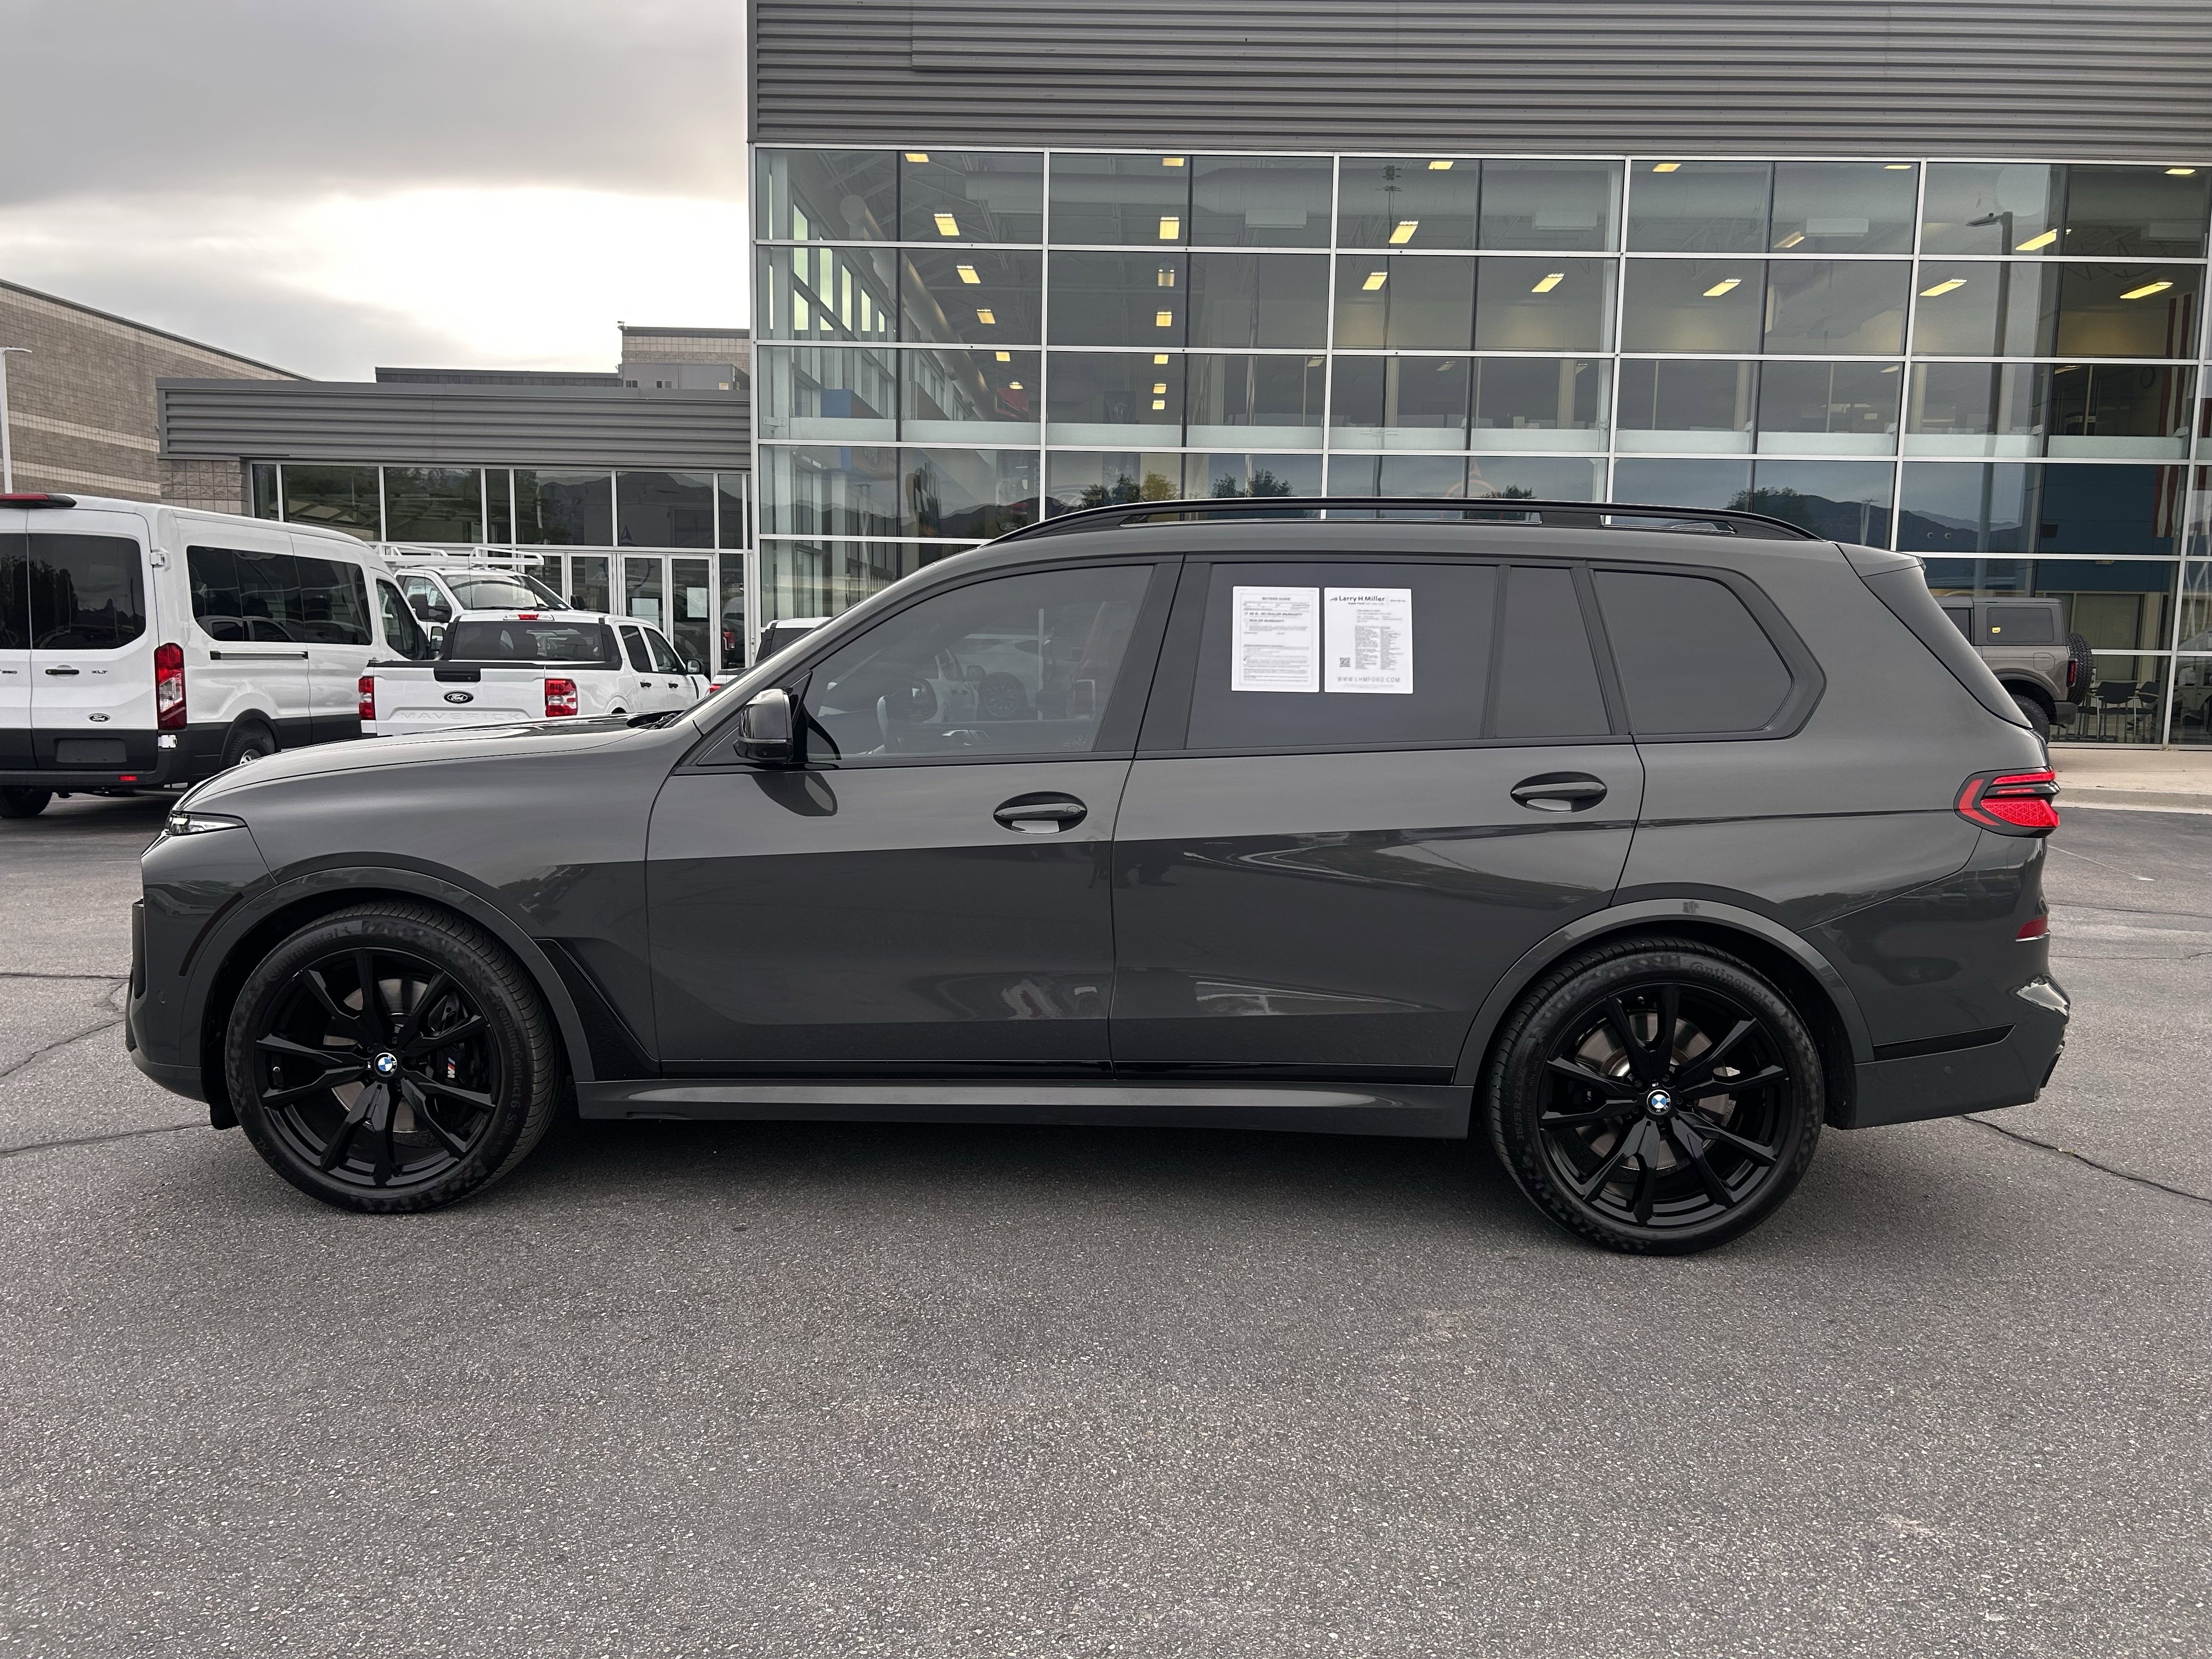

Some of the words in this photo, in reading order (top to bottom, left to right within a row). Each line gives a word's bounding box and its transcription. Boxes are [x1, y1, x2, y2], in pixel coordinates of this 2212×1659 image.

[400, 712, 521, 720] MAVERICK
[1689, 961, 1768, 1005] Continental
[495, 996, 524, 1098] PremiumContact
[503, 1113, 517, 1135] SSR
[1514, 1111, 1525, 1141] 315/35
